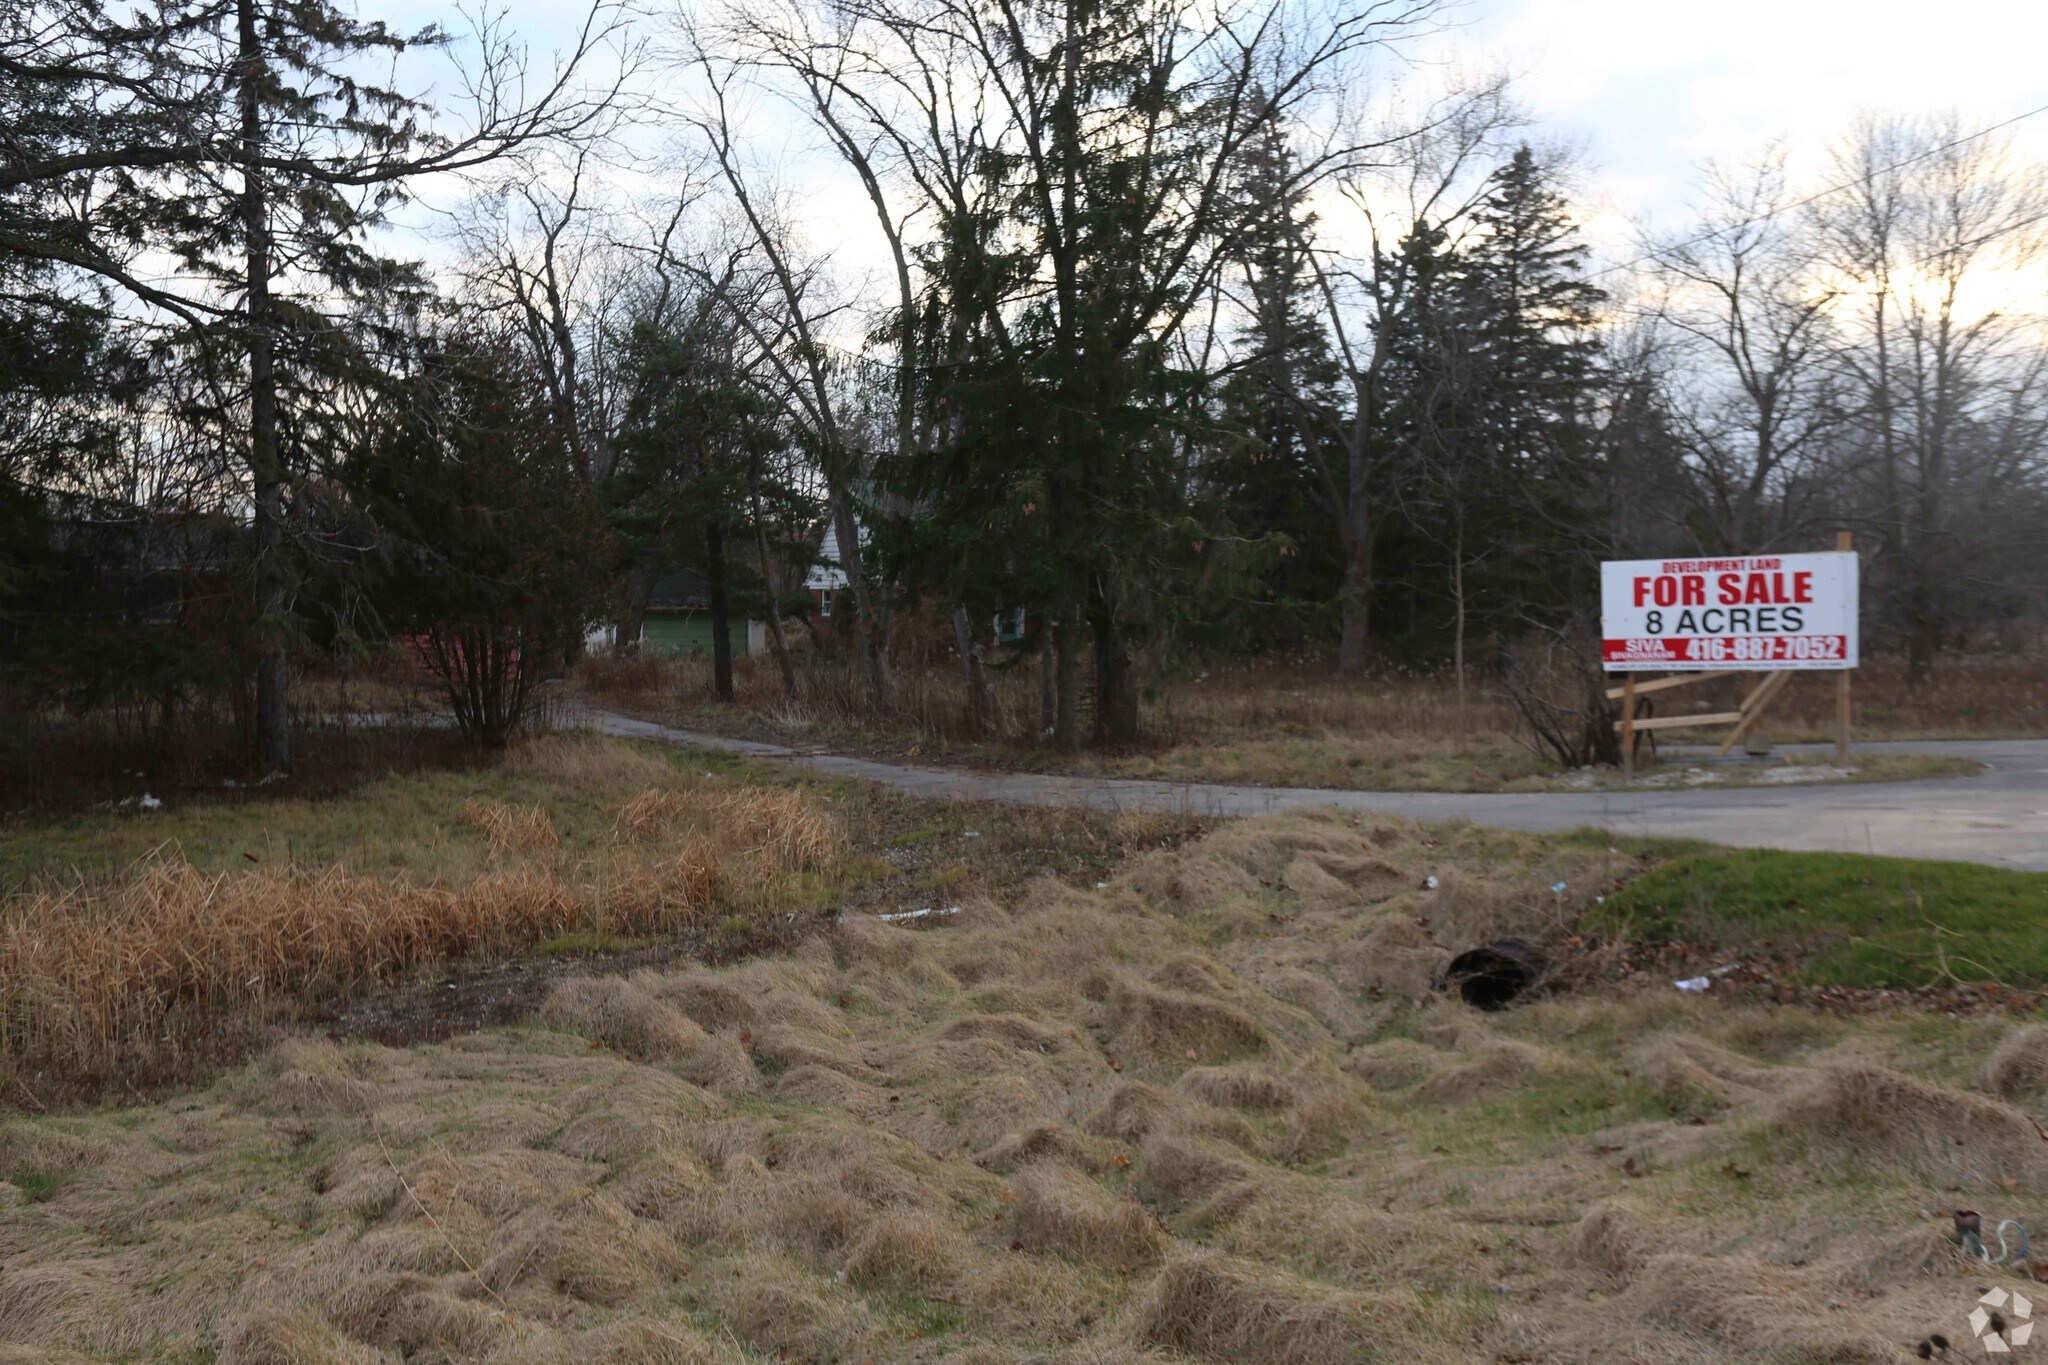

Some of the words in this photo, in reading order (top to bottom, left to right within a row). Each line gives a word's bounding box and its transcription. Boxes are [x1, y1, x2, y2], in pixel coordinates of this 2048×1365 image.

[1662, 559, 1746, 574] DEVELOPMENT
[1749, 558, 1782, 571] LAND
[1633, 575, 1706, 608] FOR
[1717, 572, 1814, 606] SALE
[1645, 610, 1663, 635] 8
[1675, 606, 1805, 634] ACRES
[1625, 638, 1666, 652] SIVA
[1685, 636, 1841, 661] 416-887-7052
